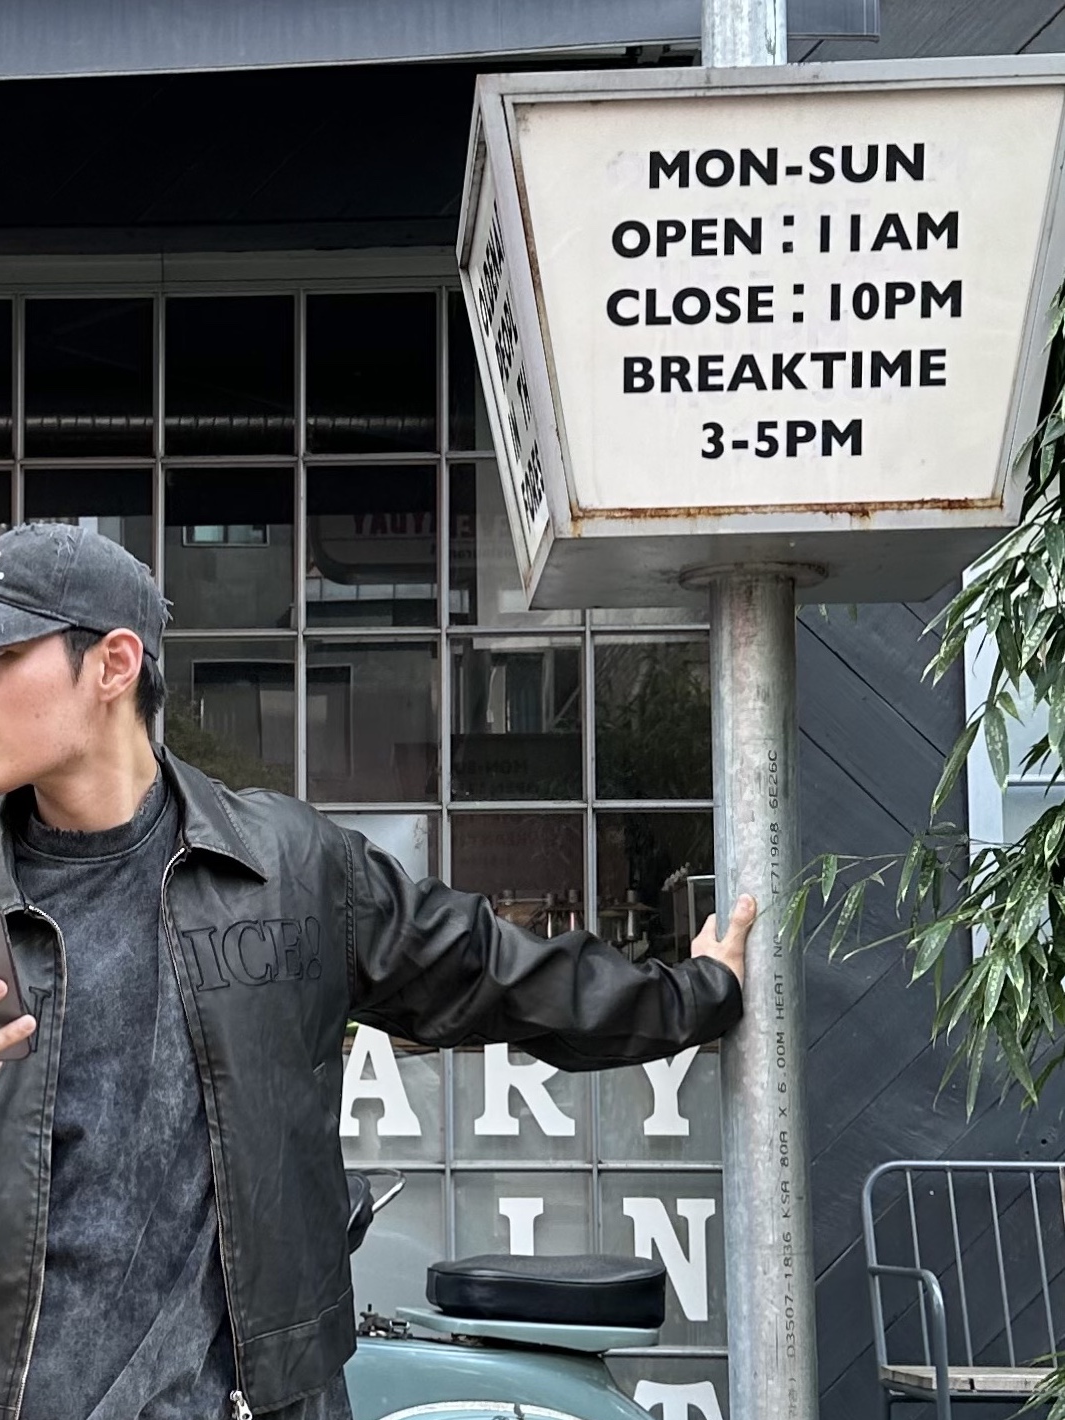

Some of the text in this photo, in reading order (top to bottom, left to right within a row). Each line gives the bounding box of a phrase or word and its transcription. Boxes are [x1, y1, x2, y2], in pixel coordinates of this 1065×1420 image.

[649, 143, 925, 189] MON-SUN
[611, 218, 762, 259] OPEN
[819, 212, 959, 253] 11AM
[478, 197, 505, 338] OLDENA
[606, 286, 774, 327] CLOSE
[830, 280, 962, 321] 10PM
[495, 289, 519, 395] PEOPL
[623, 349, 947, 394] BREAKTIME
[701, 419, 863, 460] 3-5PM
[520, 438, 545, 534] FORES
[774, 973, 785, 1021] HEAT
